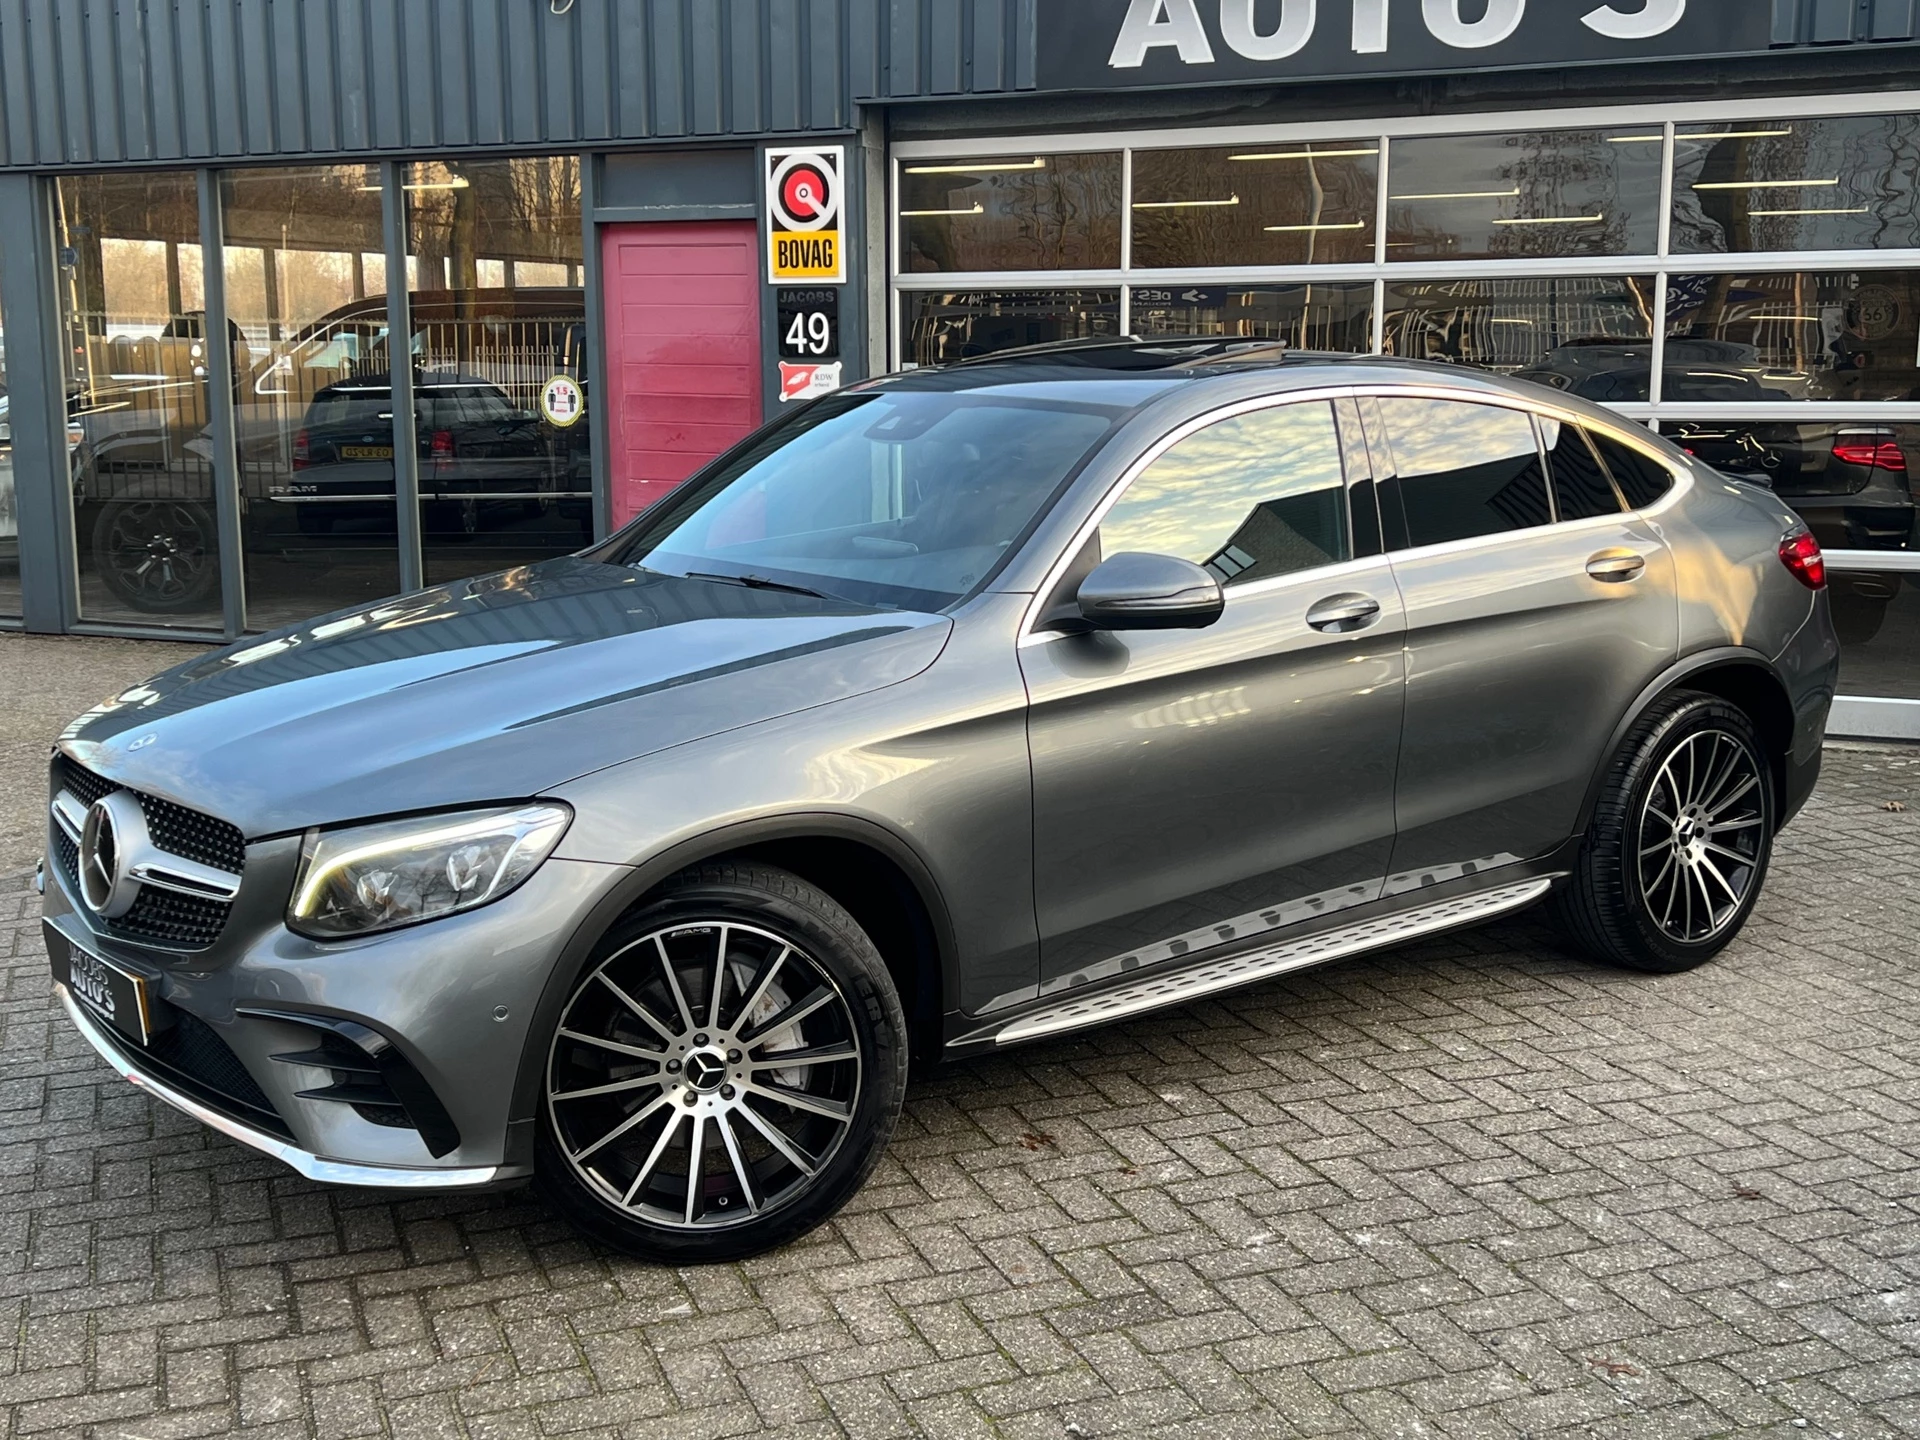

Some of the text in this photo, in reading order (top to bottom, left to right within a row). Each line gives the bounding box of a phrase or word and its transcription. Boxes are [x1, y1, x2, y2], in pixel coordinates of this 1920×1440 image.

[1108, 0, 1686, 67] AUTO
[778, 239, 833, 269] BOVAG
[780, 291, 835, 303] JACOBS
[785, 312, 830, 354] 49
